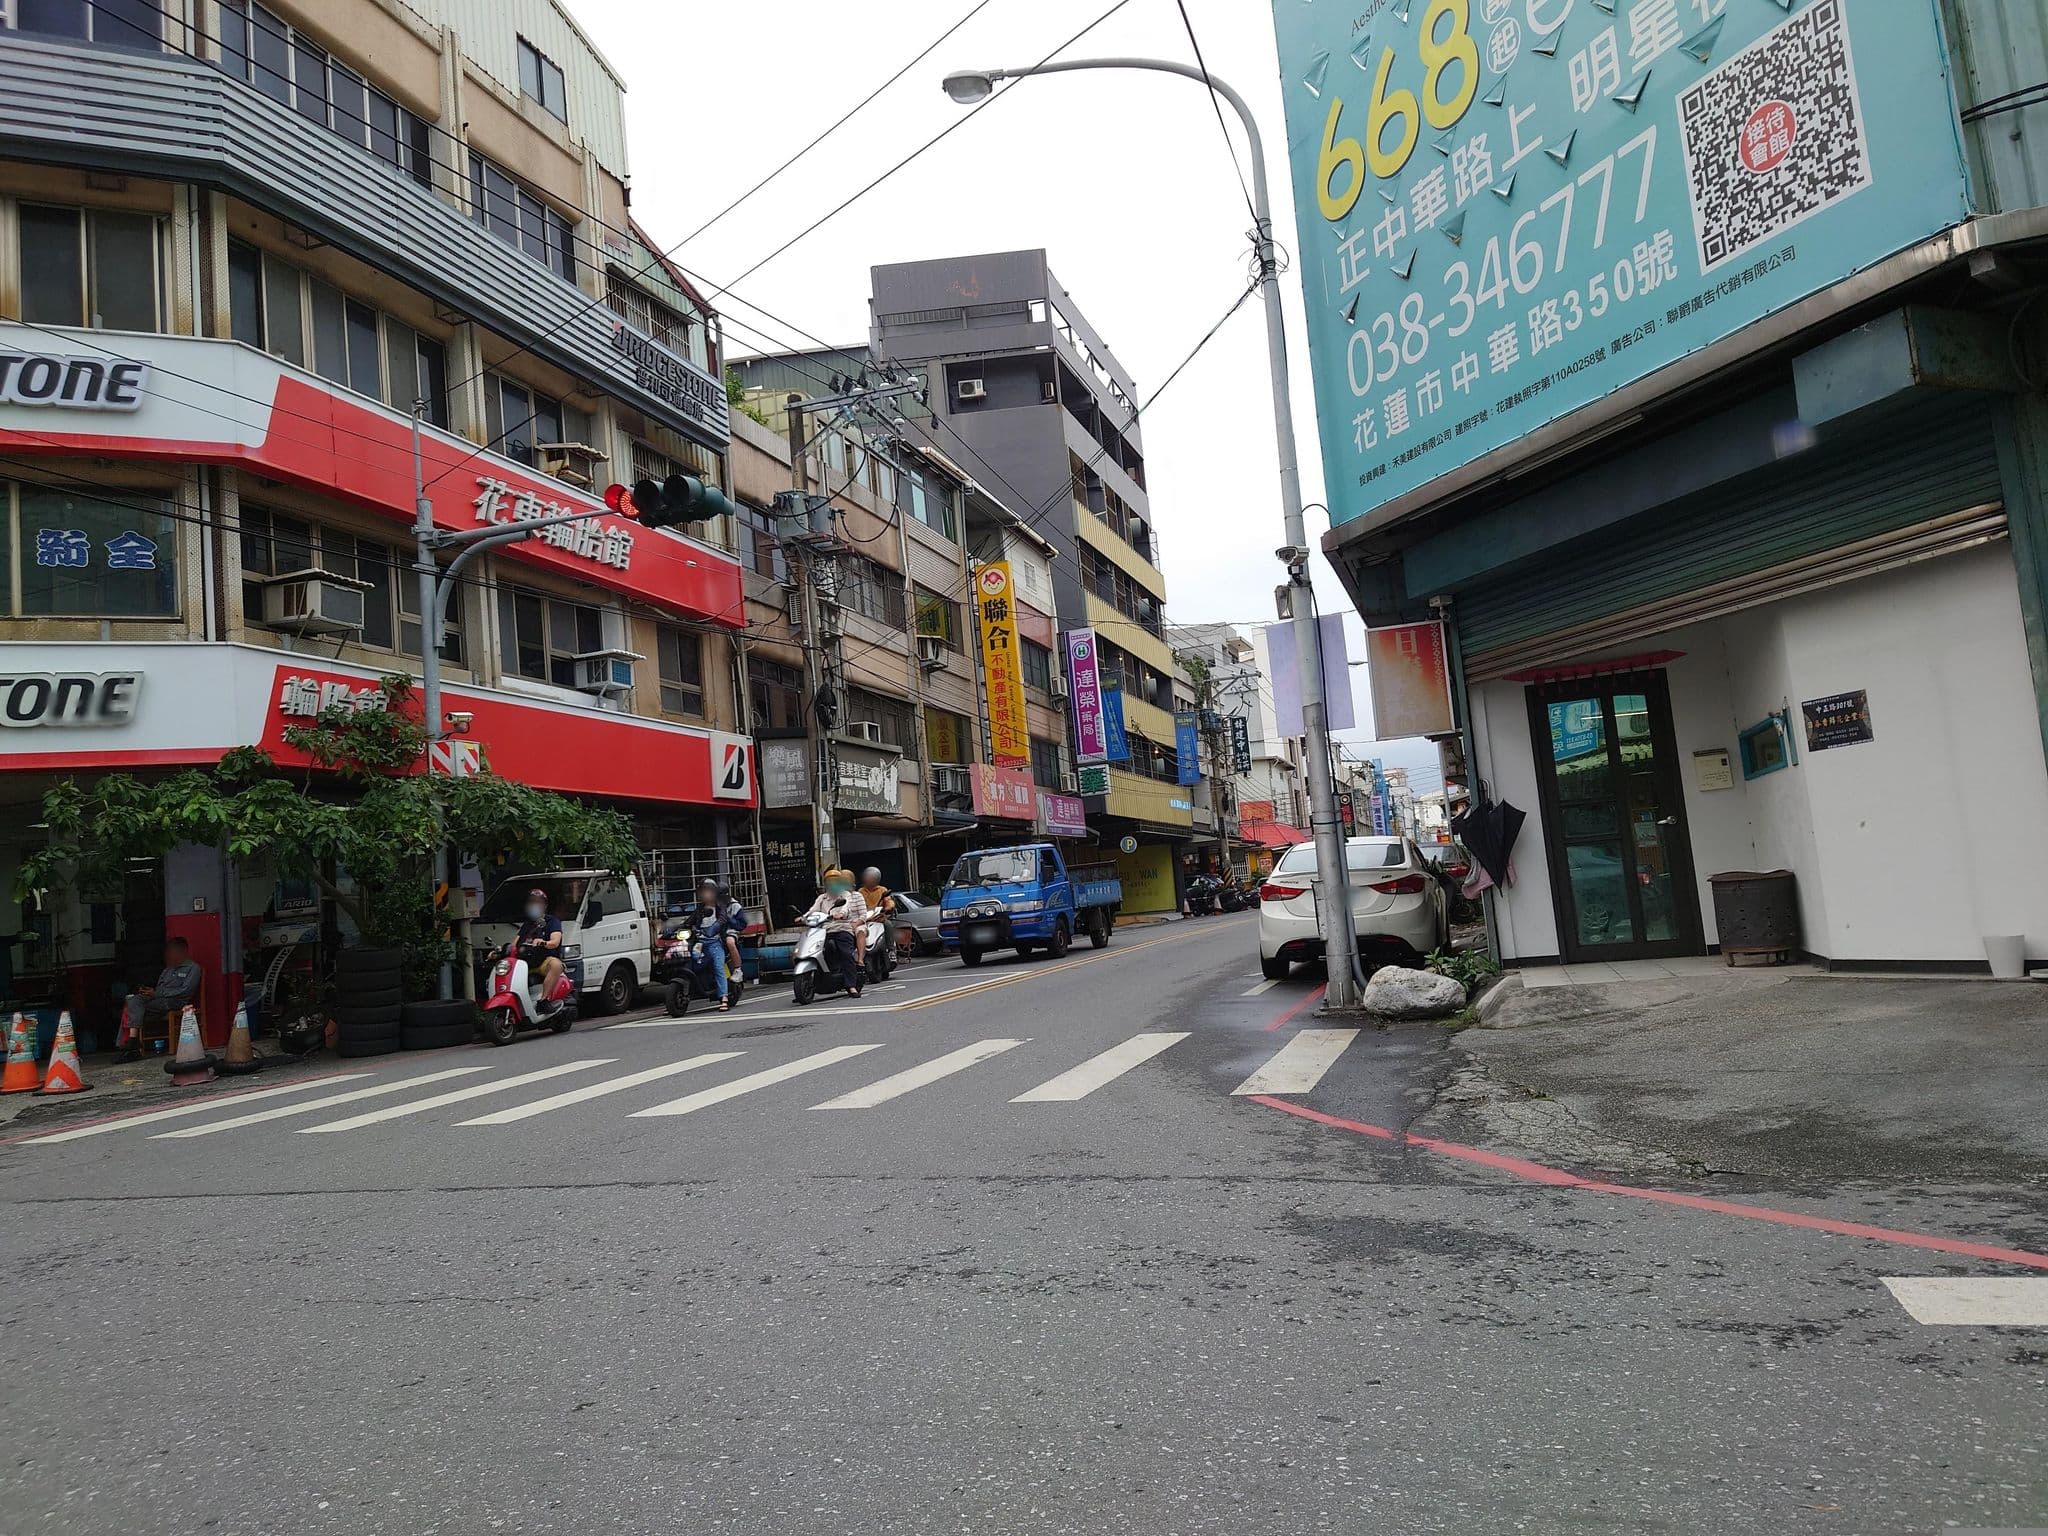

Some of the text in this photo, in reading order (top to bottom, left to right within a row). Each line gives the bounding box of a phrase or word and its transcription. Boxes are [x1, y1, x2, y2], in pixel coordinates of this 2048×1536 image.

[1316, 0, 1480, 219] 668
[1337, 0, 1729, 294] 正中華路上 明星
[1746, 106, 1786, 148] 接待
[1749, 127, 1790, 168] 會館
[1347, 124, 1657, 398] 038-346777
[612, 321, 722, 411] BRIDGESTONE
[1353, 228, 1678, 454] 花蓮市中華路350號
[473, 477, 634, 570] 花東輪胎館
